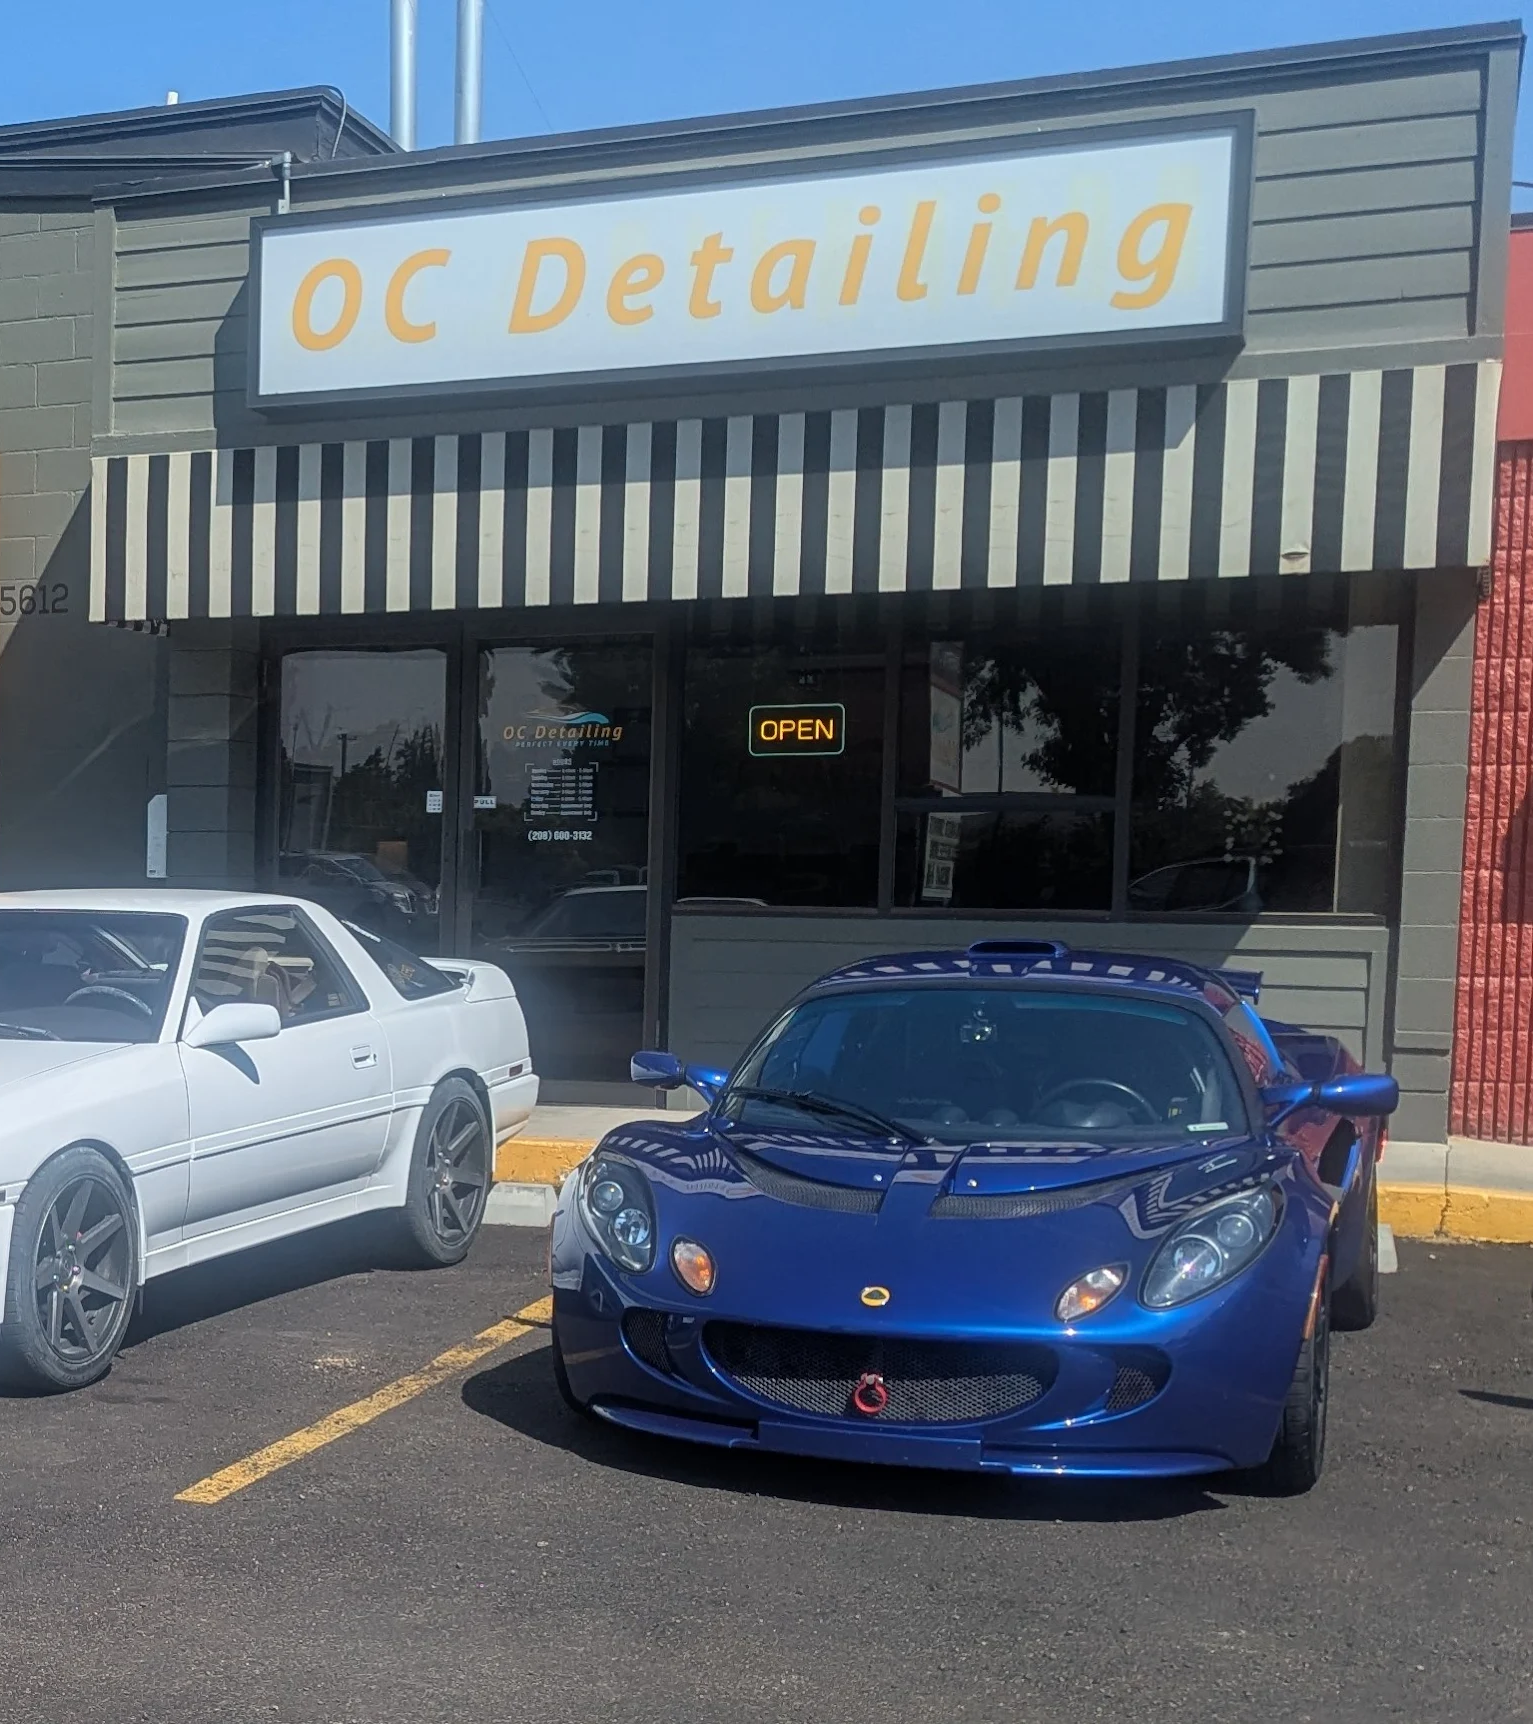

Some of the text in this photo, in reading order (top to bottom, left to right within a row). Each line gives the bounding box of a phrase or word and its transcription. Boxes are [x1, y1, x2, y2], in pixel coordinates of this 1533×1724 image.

[291, 192, 1195, 353] OC Detailing
[0, 583, 69, 616] 5612
[503, 723, 623, 741] OC Detailing
[760, 718, 834, 741] OPEN
